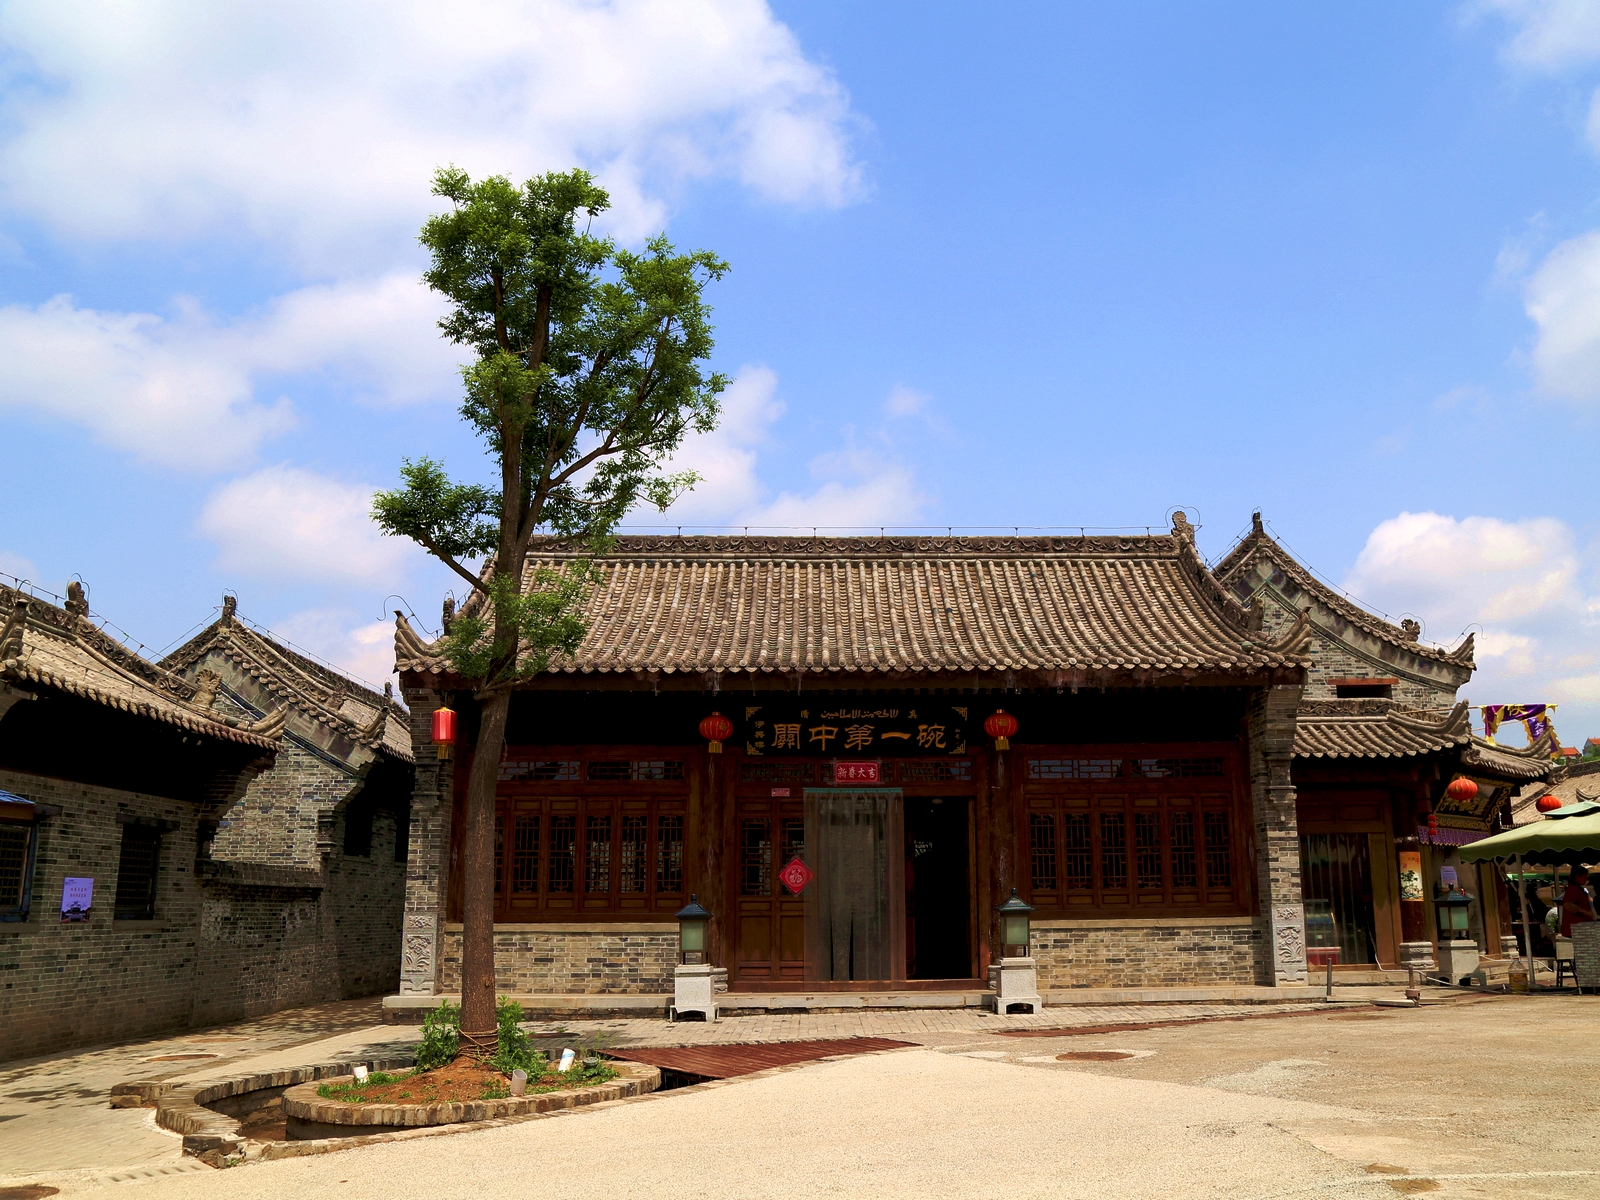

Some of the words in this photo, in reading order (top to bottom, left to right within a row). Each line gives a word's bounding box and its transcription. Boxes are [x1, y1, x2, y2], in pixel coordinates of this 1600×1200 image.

[771, 722, 947, 751] 關中第一碗
[837, 766, 877, 779] 新春大吉
